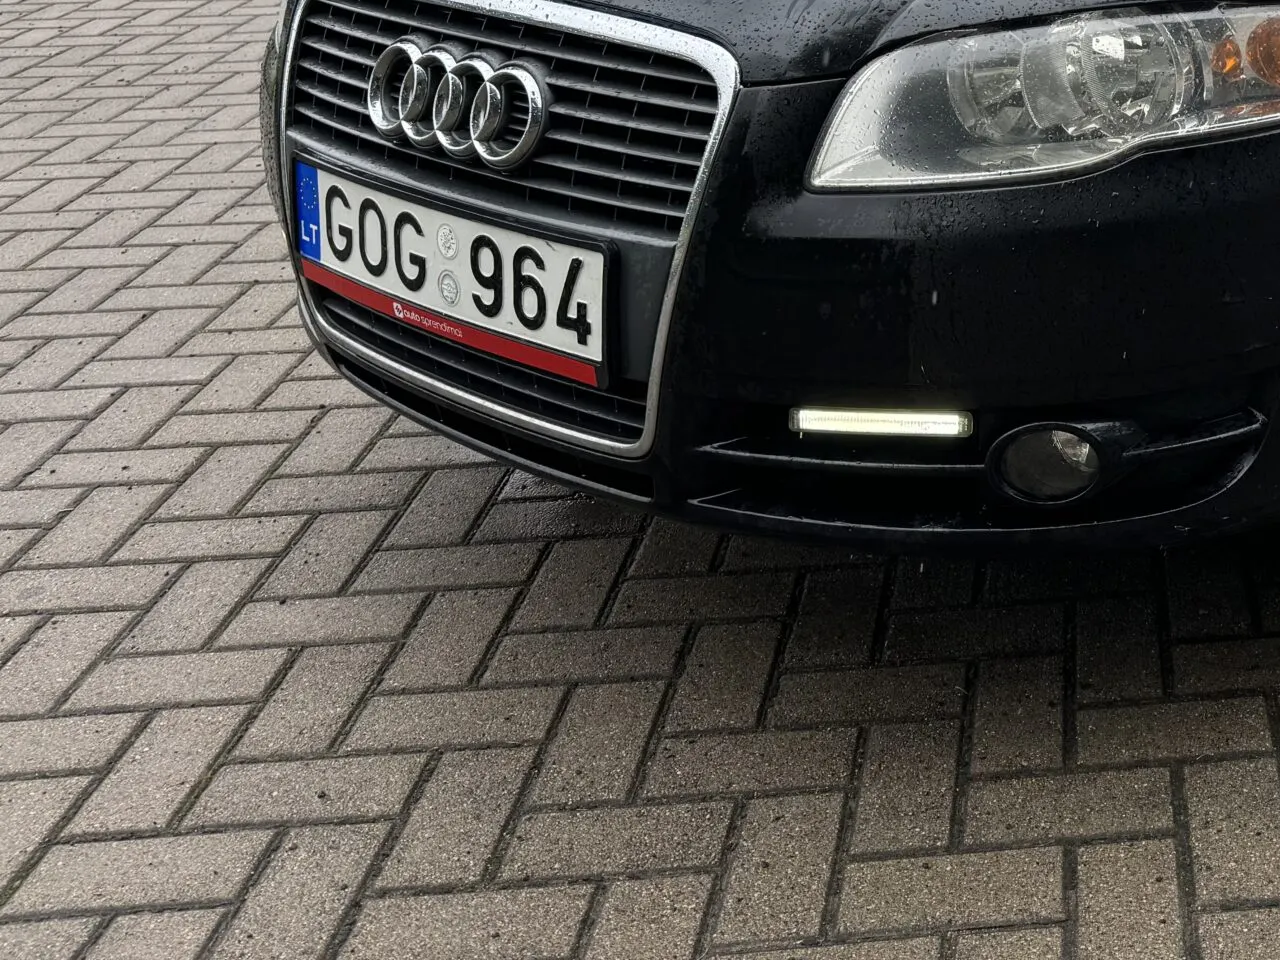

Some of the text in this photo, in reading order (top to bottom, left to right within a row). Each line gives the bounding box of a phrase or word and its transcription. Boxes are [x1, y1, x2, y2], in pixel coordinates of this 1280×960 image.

[301, 220, 318, 245] LT
[324, 184, 592, 346] GOG 964
[403, 309, 421, 322] auto
